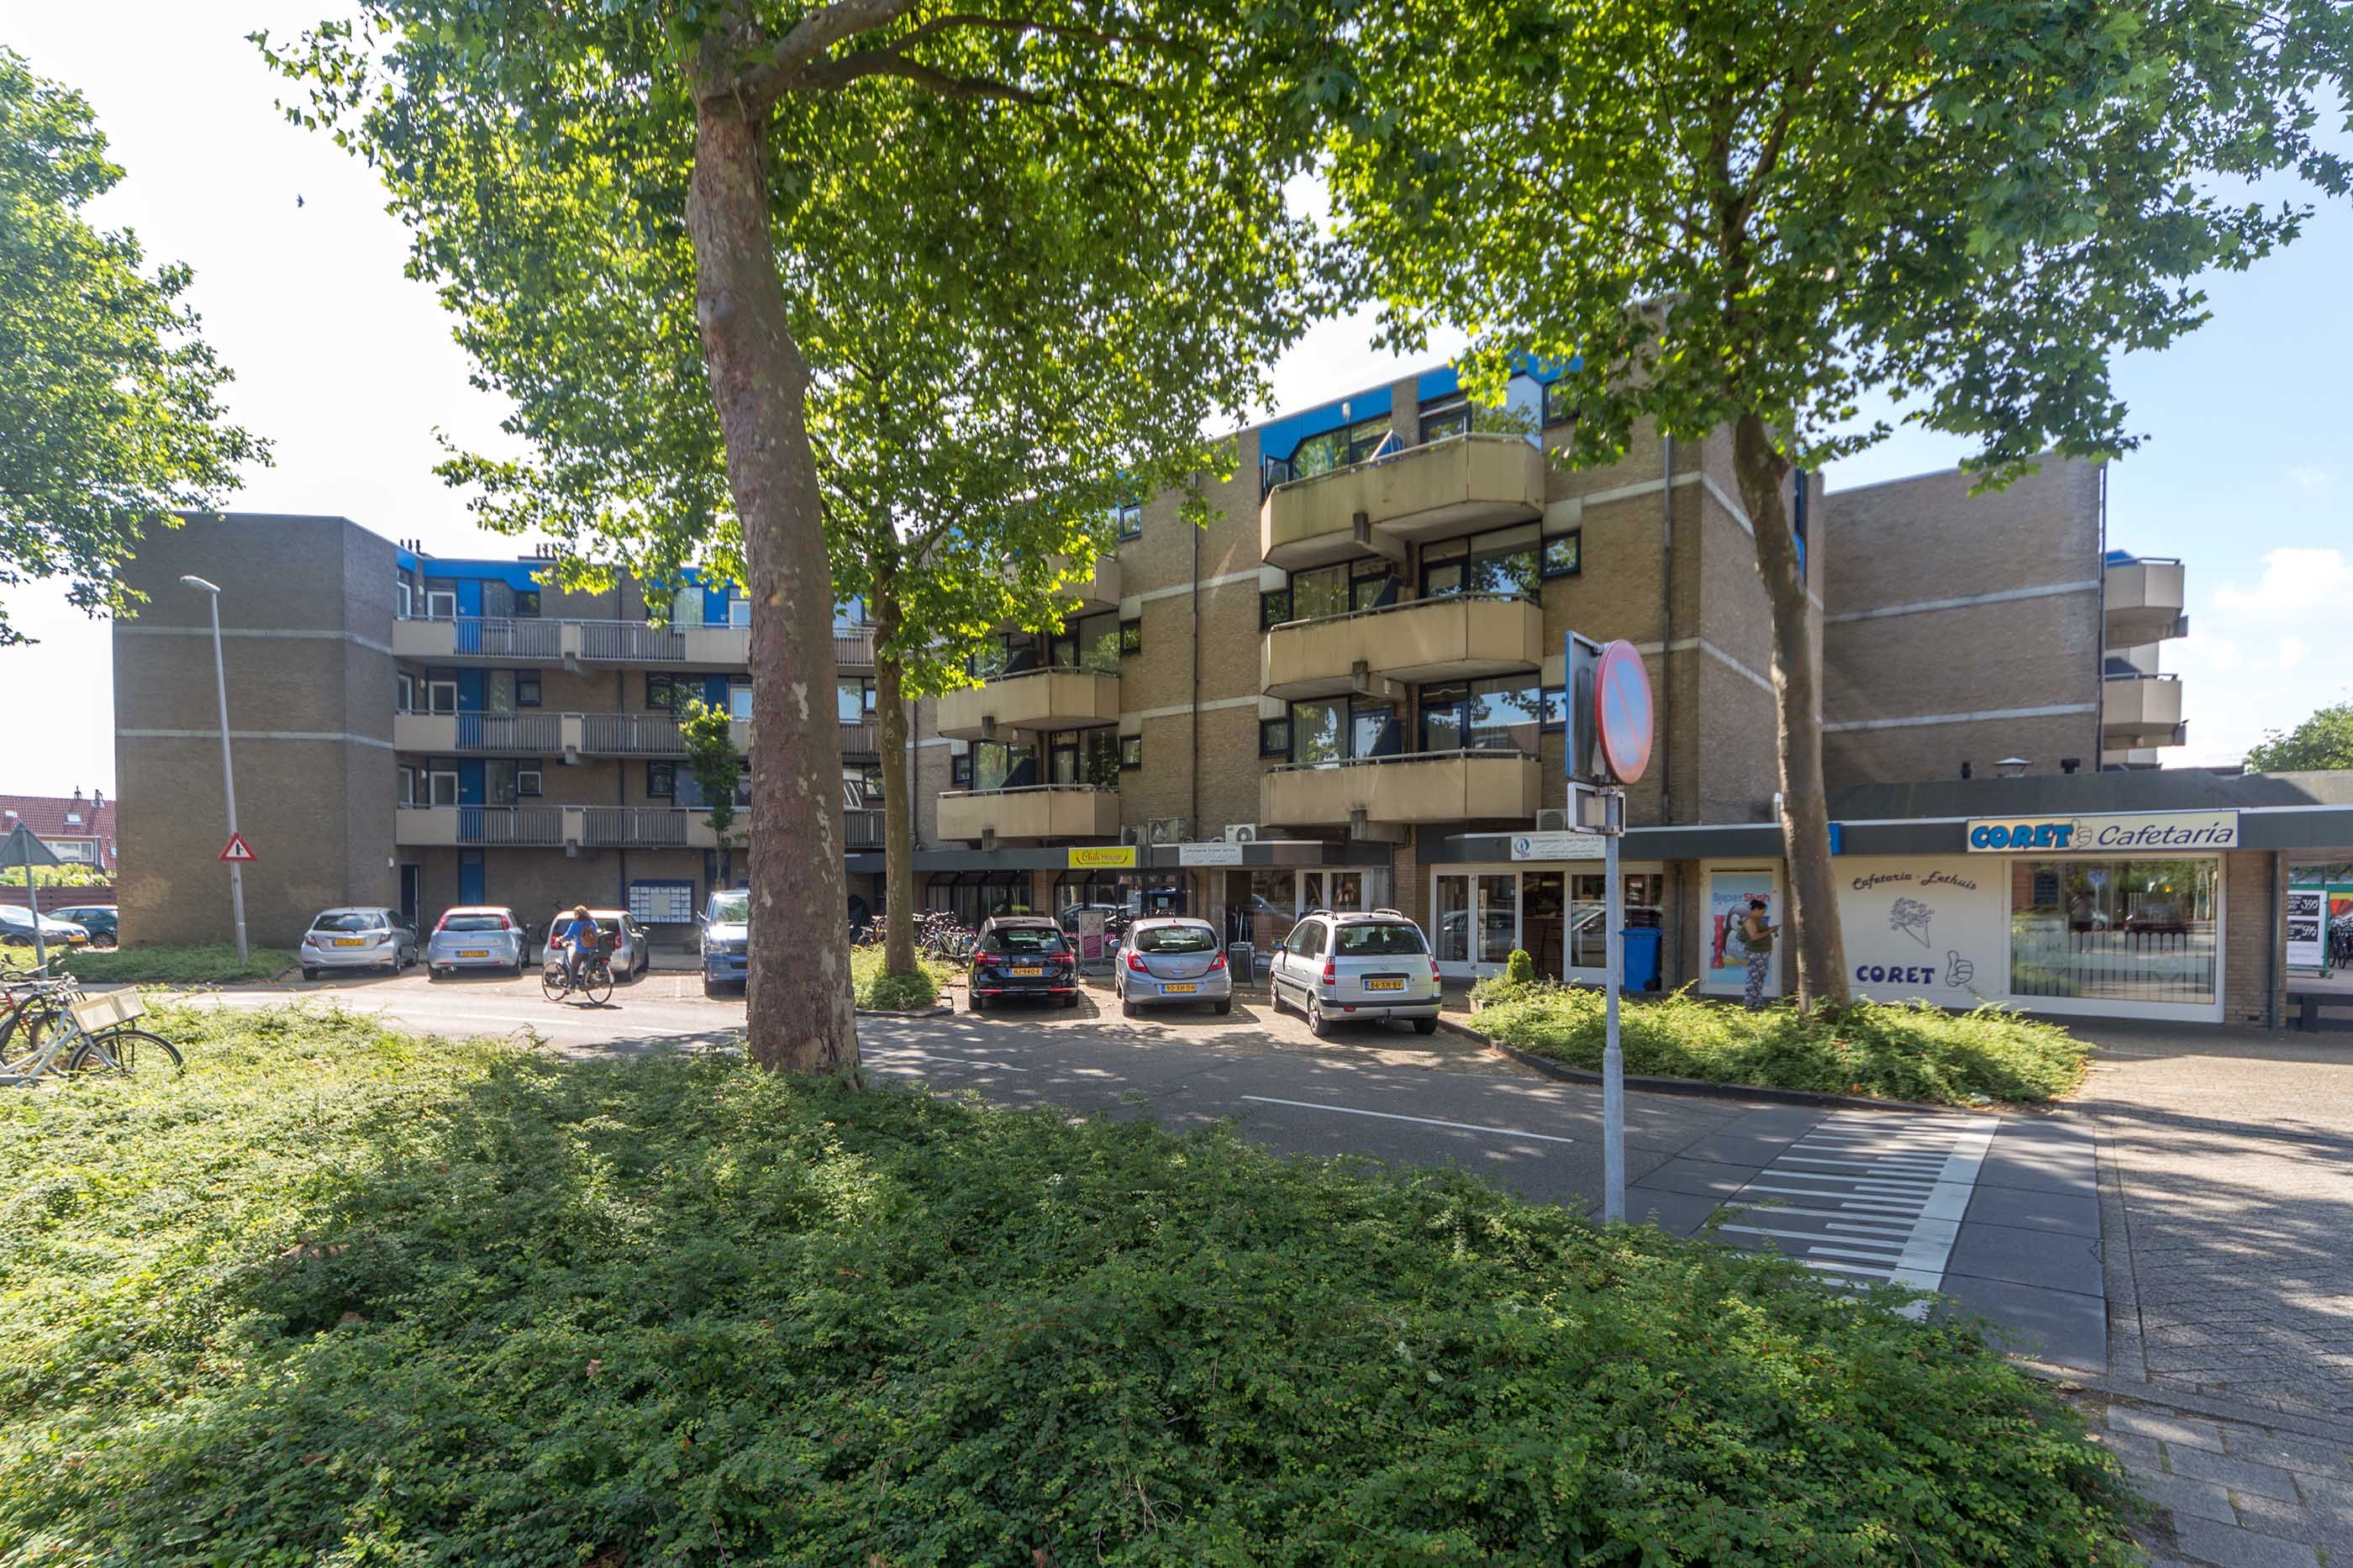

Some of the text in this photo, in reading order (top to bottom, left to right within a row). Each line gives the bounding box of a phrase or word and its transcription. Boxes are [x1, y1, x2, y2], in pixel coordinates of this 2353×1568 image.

[1971, 822, 2235, 850] CORET Cafetaria
[1082, 850, 1122, 861] Chili House
[1852, 871, 1977, 890] Cafetaria Eethuis
[1713, 892, 1770, 903] Super Slush
[1856, 965, 1935, 984] CORET
